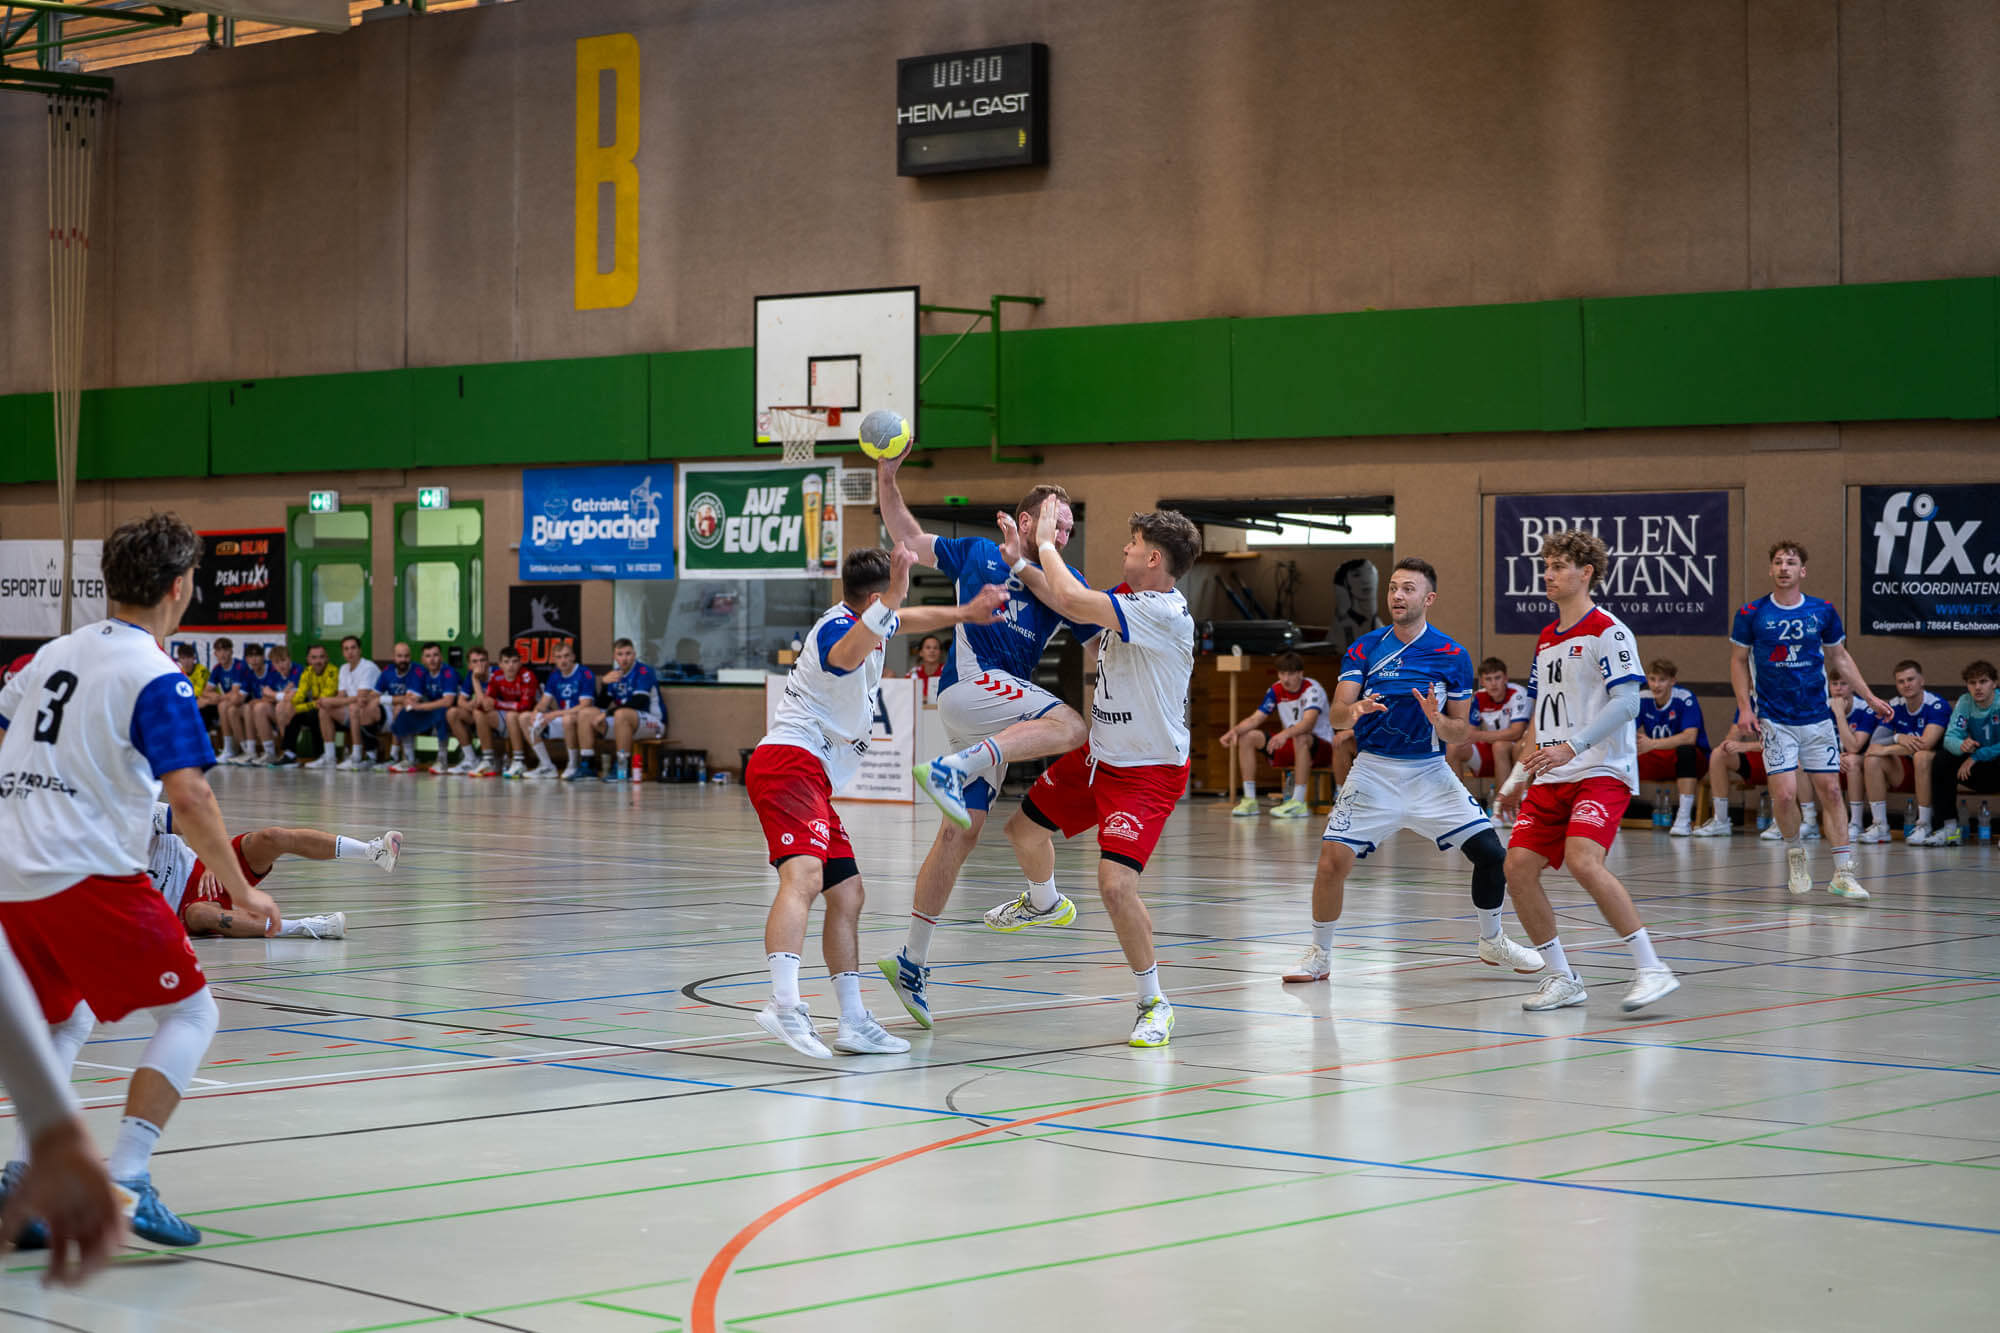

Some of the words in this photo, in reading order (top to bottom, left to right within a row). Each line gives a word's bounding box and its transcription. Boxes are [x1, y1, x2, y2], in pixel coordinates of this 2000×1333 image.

[898, 102, 952, 125] HEIM
[973, 93, 1030, 117] GAST
[574, 32, 641, 312] B
[571, 498, 630, 513] Getränke
[742, 487, 790, 516] AUF
[532, 513, 660, 546] Burgbacher
[723, 515, 803, 554] EUCH
[1873, 491, 1983, 575] fix
[1, 579, 46, 598] SPORT
[49, 579, 105, 598] WLTER
[1504, 555, 1716, 597] LEMANN
[1872, 582, 1899, 595] CNC
[1900, 582, 2000, 596] KOORDINATEN
[1516, 602, 1557, 612] MODE
[1621, 602, 1649, 613] VOR
[1656, 602, 1704, 612] AUGEN
[1935, 603, 2000, 616] WWW.FIX-
[1778, 619, 1804, 641] 23
[1872, 621, 1914, 633] Geigenrain
[1546, 657, 1562, 684] 18
[34, 670, 78, 744] 3
